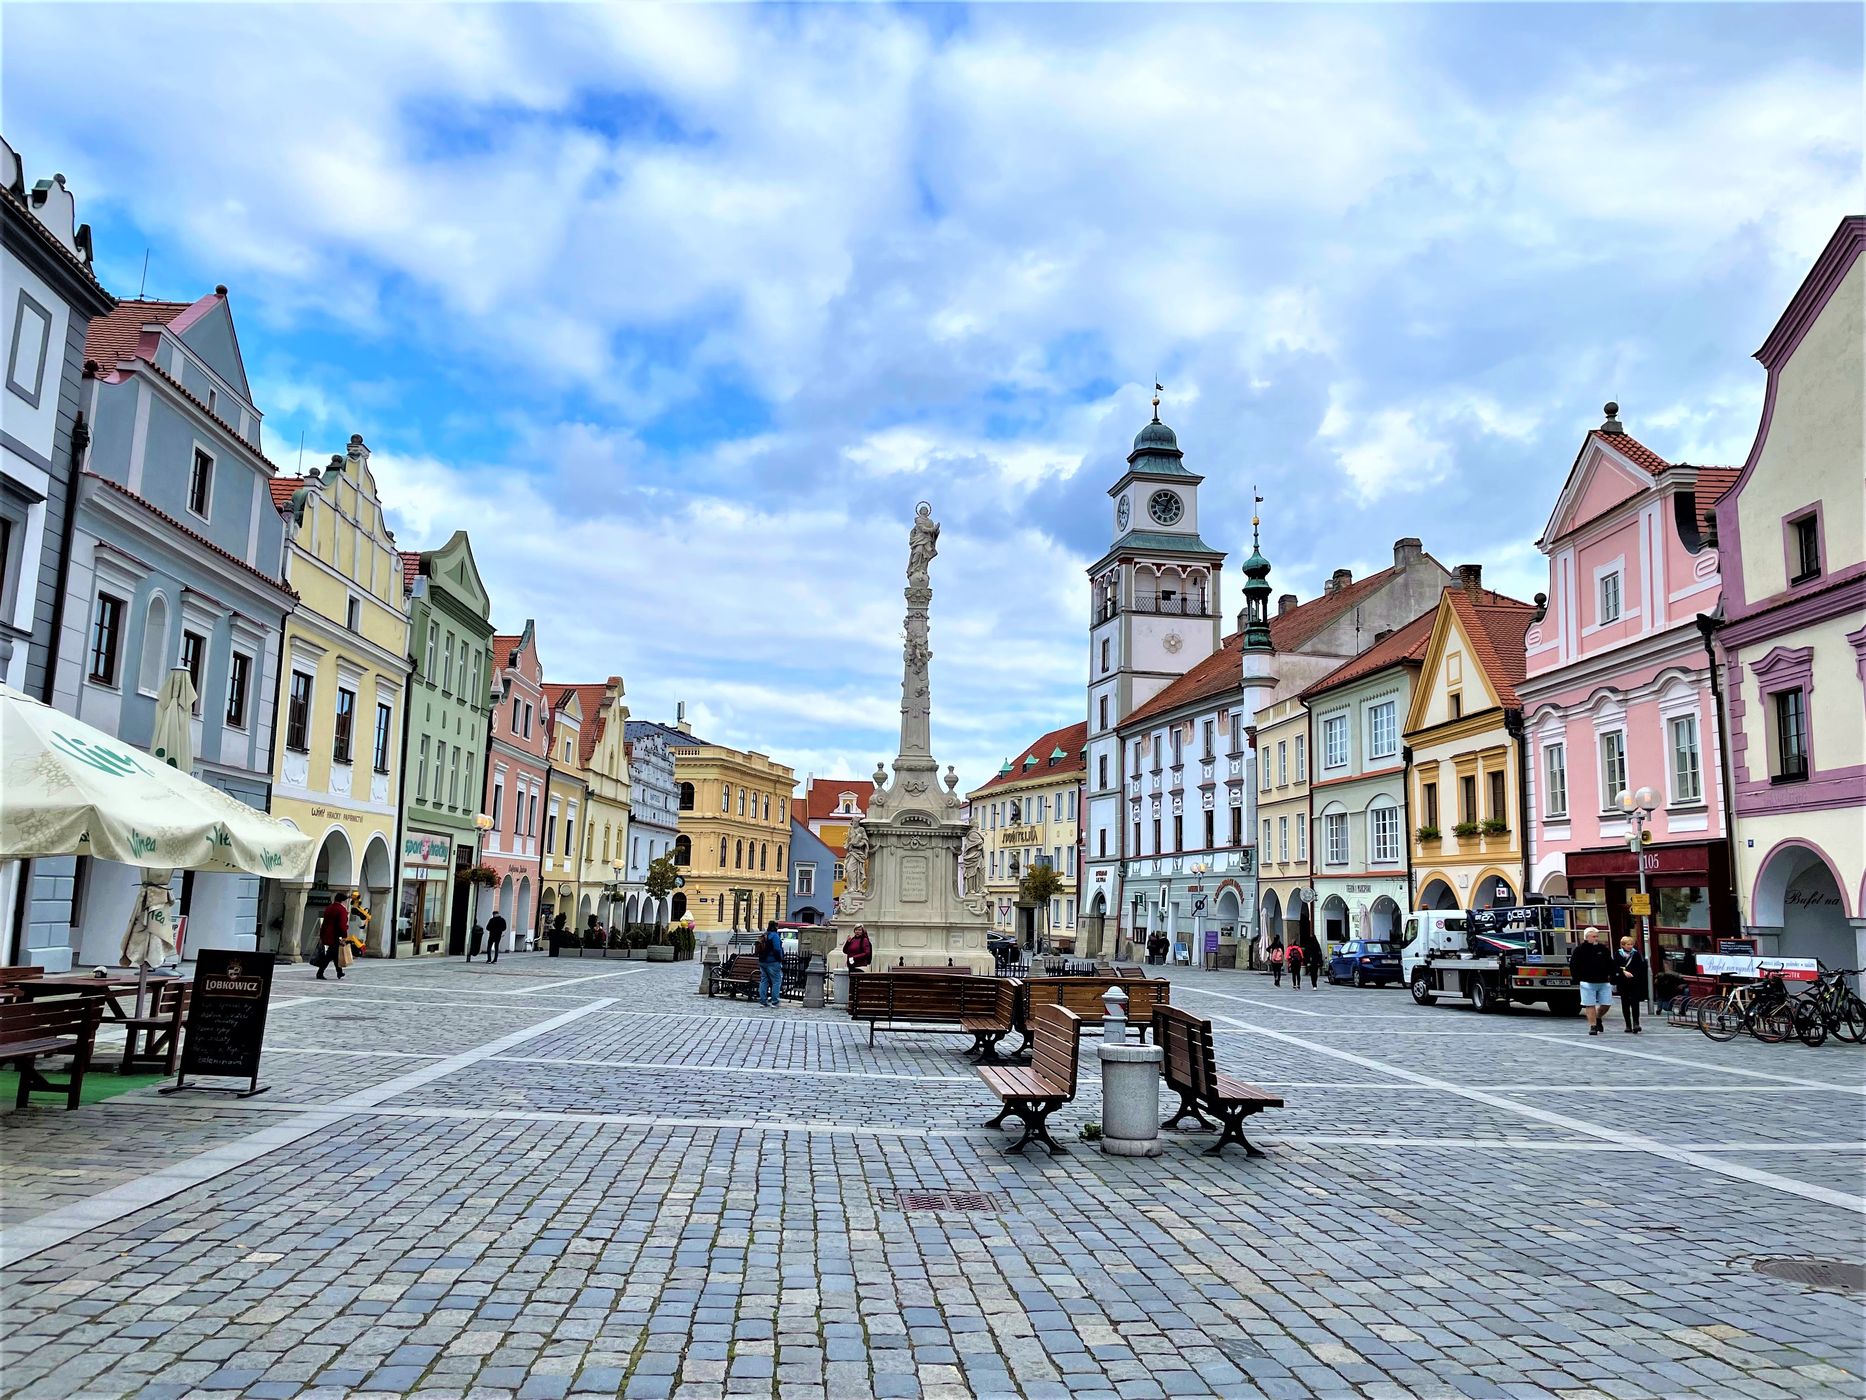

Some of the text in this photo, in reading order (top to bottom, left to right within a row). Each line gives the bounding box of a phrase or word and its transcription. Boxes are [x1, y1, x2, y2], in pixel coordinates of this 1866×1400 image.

[126, 827, 157, 859] Vinea
[405, 839, 423, 856] sport
[1643, 853, 1659, 869] 105
[1785, 889, 1825, 910] Bufet
[205, 979, 258, 991] LOBKOWICZ
